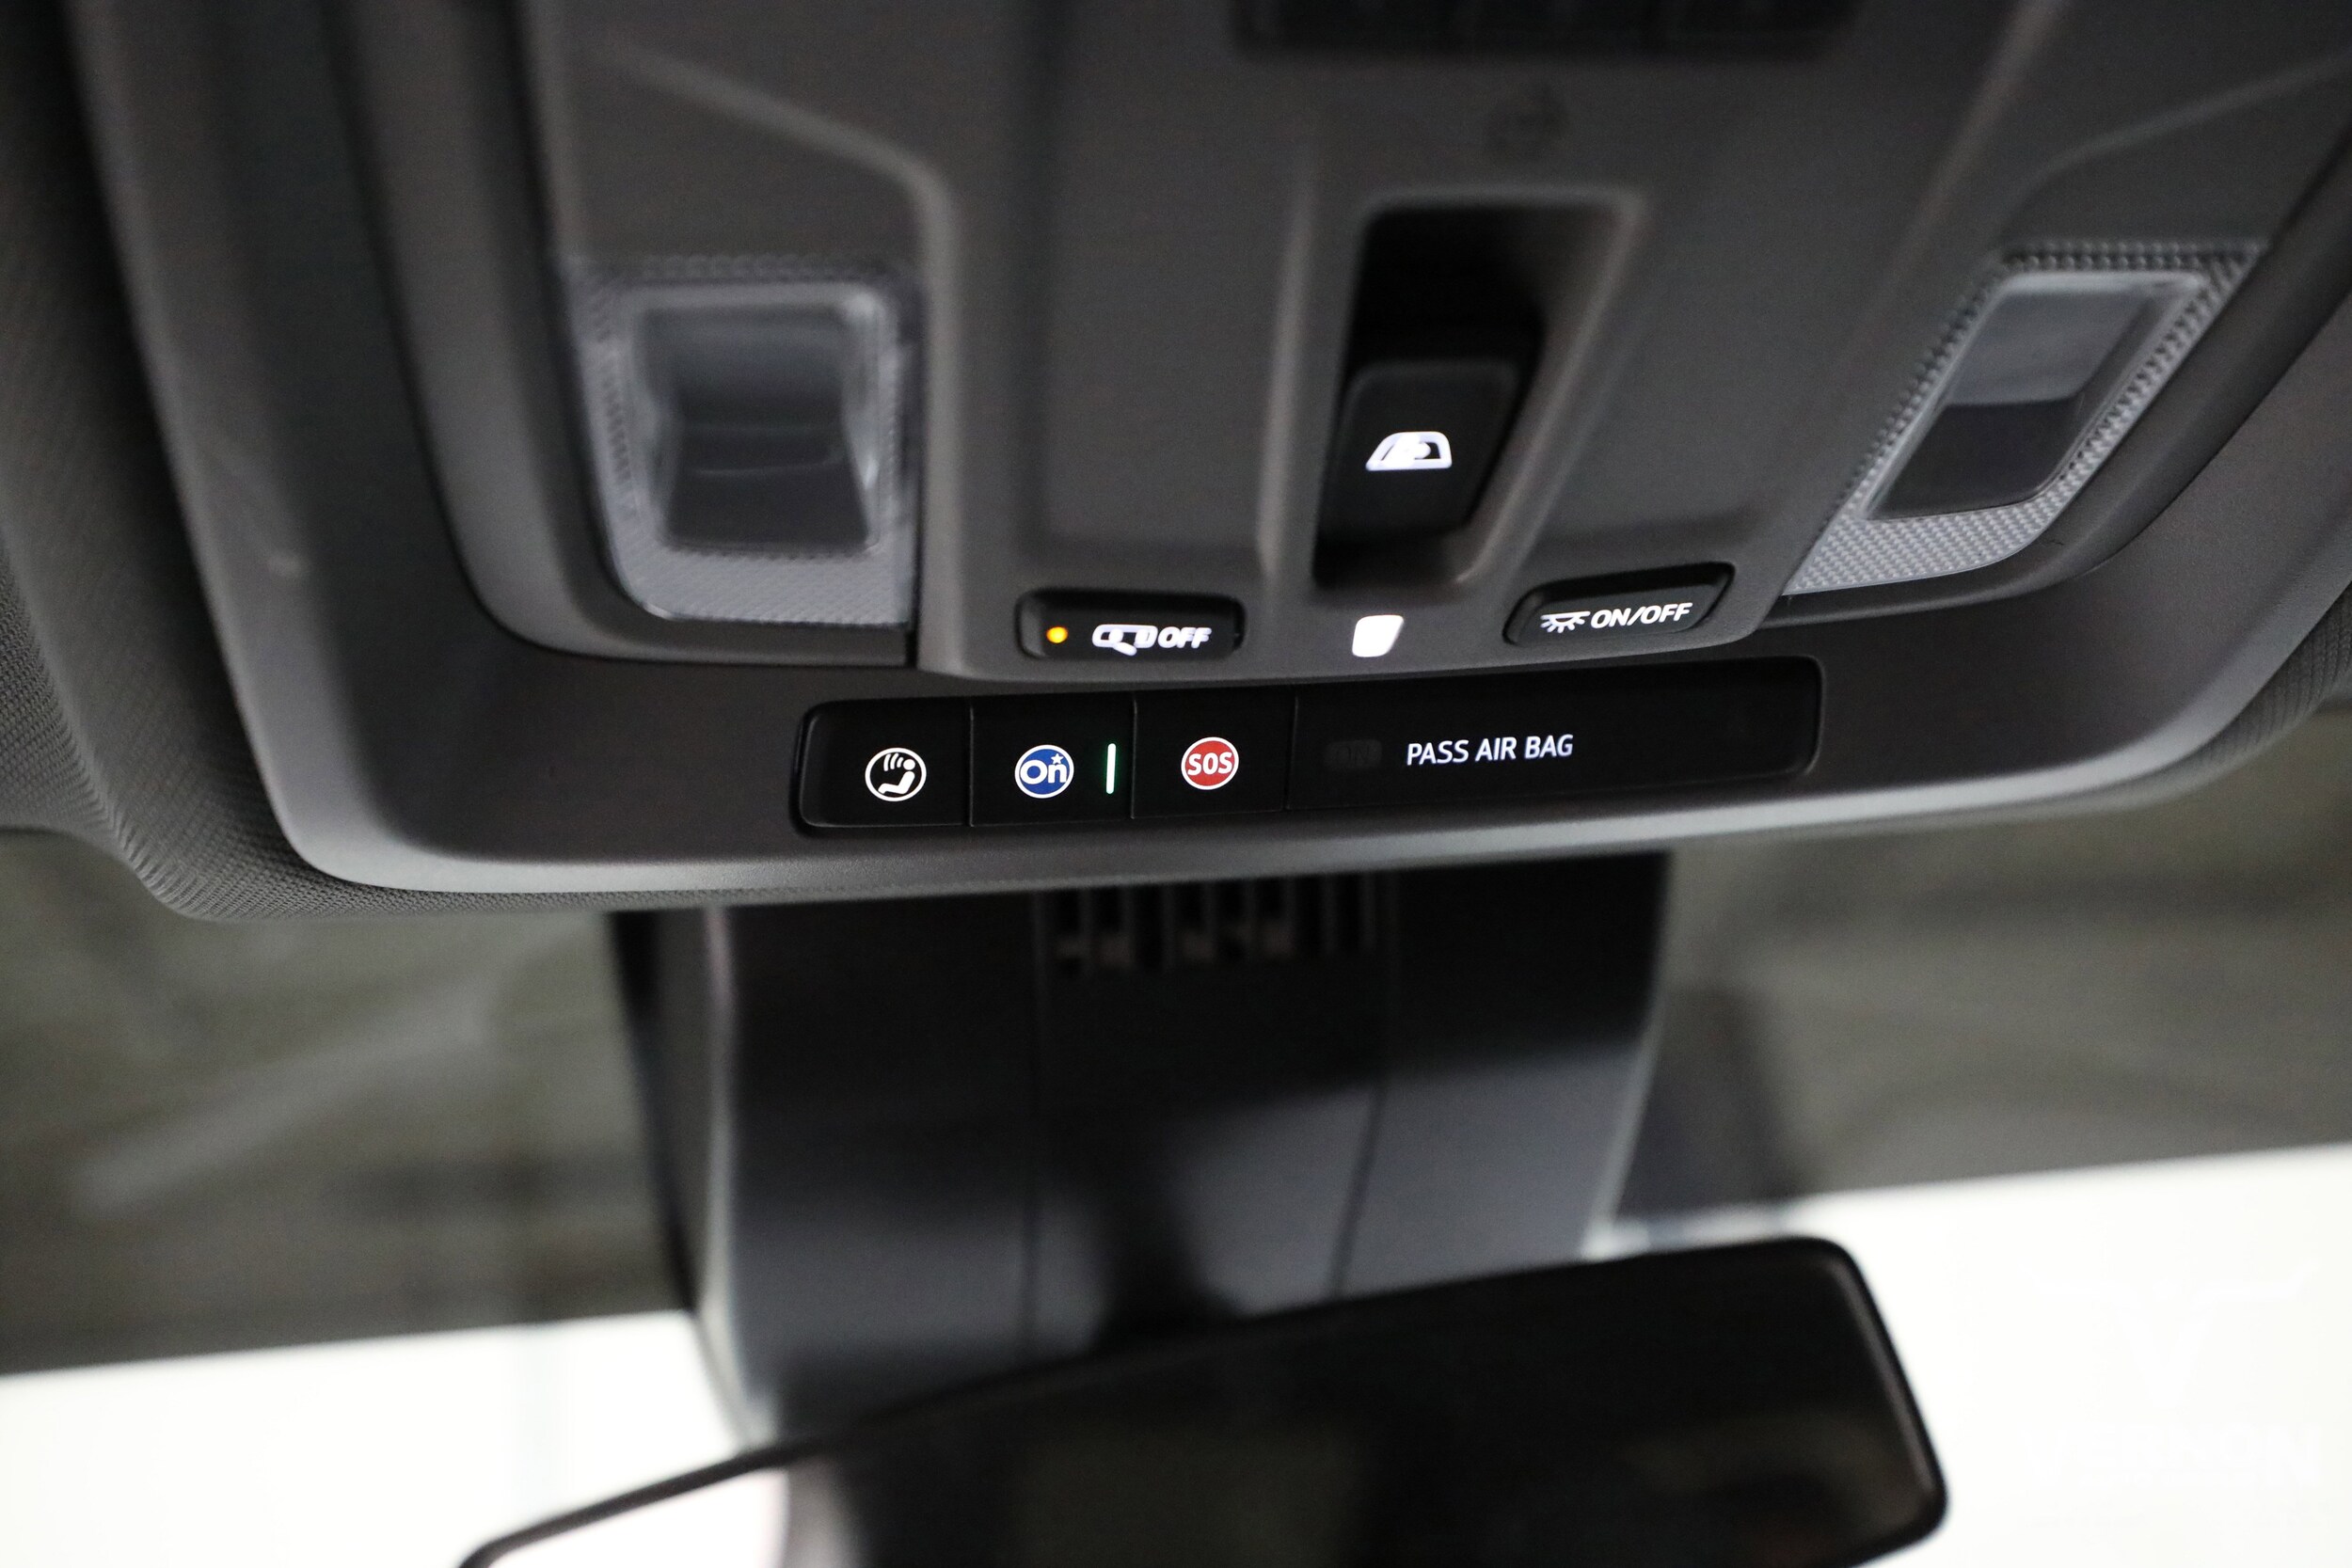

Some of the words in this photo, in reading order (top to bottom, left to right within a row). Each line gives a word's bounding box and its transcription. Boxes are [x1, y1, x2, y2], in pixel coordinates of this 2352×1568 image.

[1590, 602, 1692, 629] ON/OFF
[1157, 626, 1213, 648] OFF
[1406, 740, 1469, 766] PASS
[1475, 736, 1517, 761] AIR
[1524, 734, 1574, 758] BAG
[1020, 759, 1067, 784] On
[1187, 752, 1233, 776] SOS
